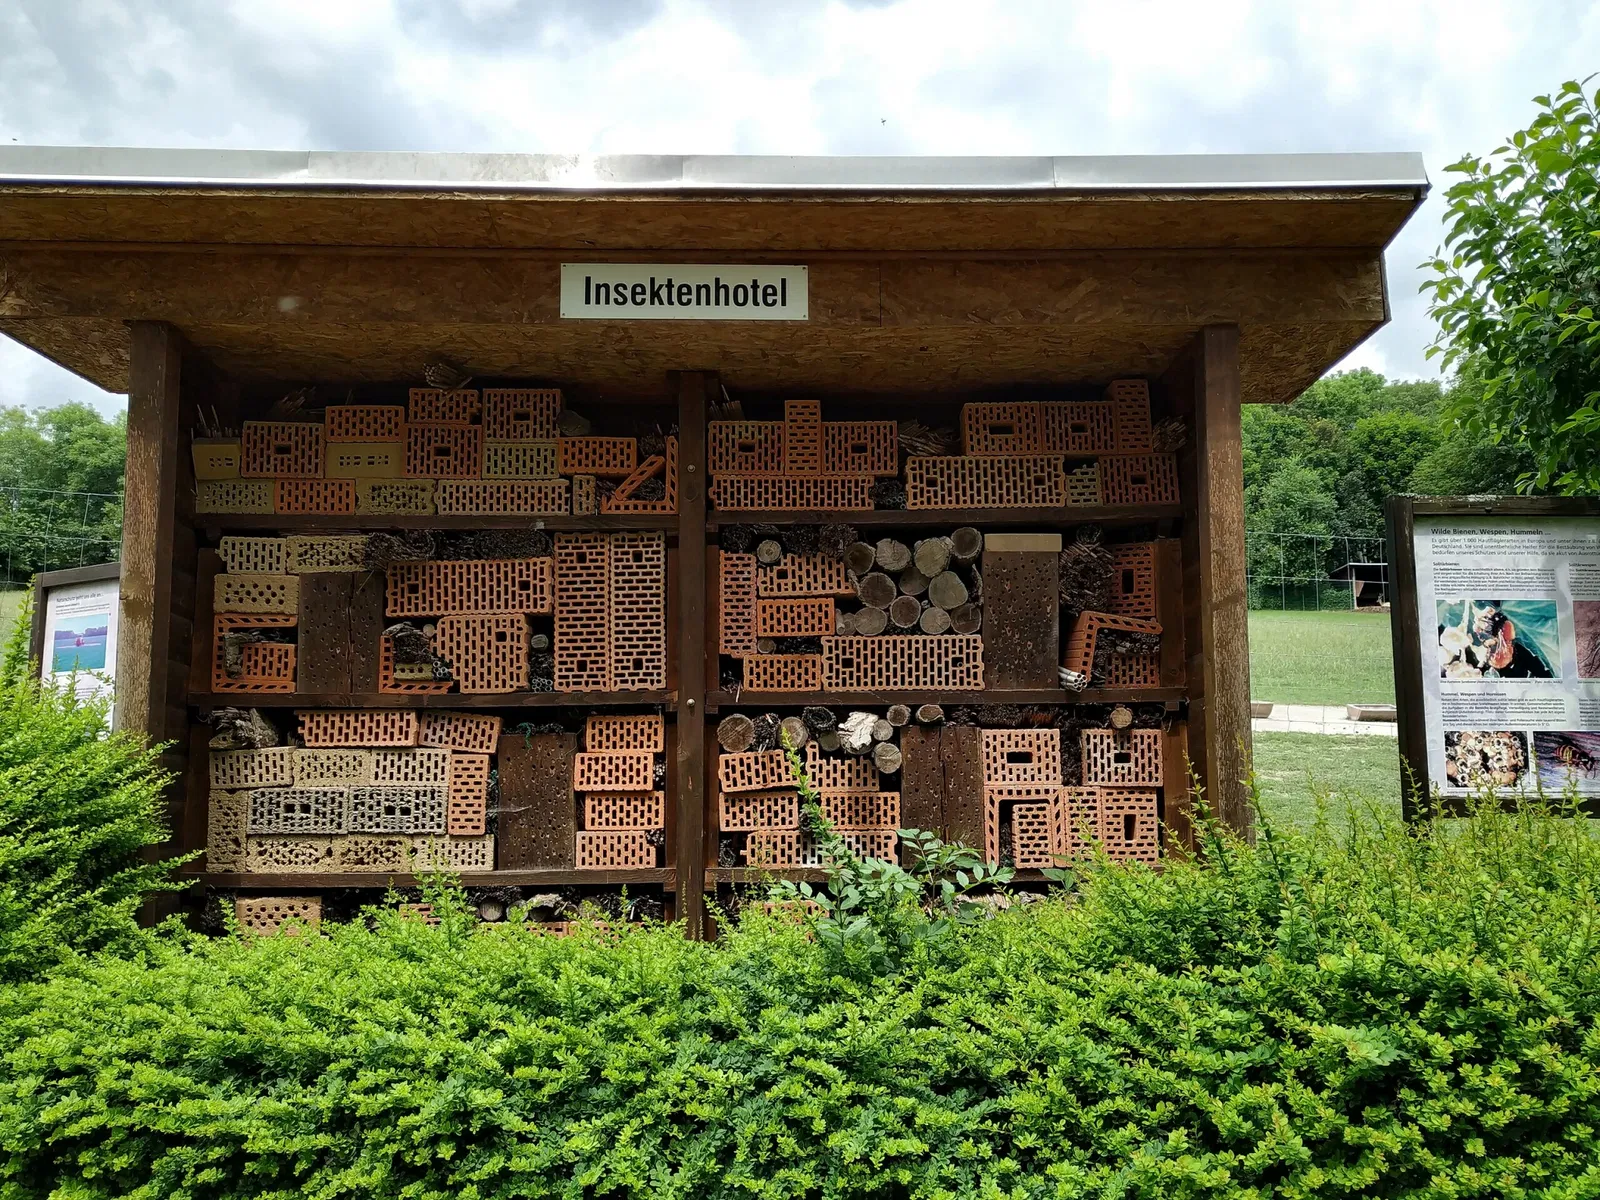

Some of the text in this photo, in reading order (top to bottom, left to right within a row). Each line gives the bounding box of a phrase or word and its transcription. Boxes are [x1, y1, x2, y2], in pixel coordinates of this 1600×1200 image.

[584, 276, 787, 307] Insektenhotel
[1452, 528, 1478, 536] Bienen,
[1479, 528, 1509, 536] Wespen,
